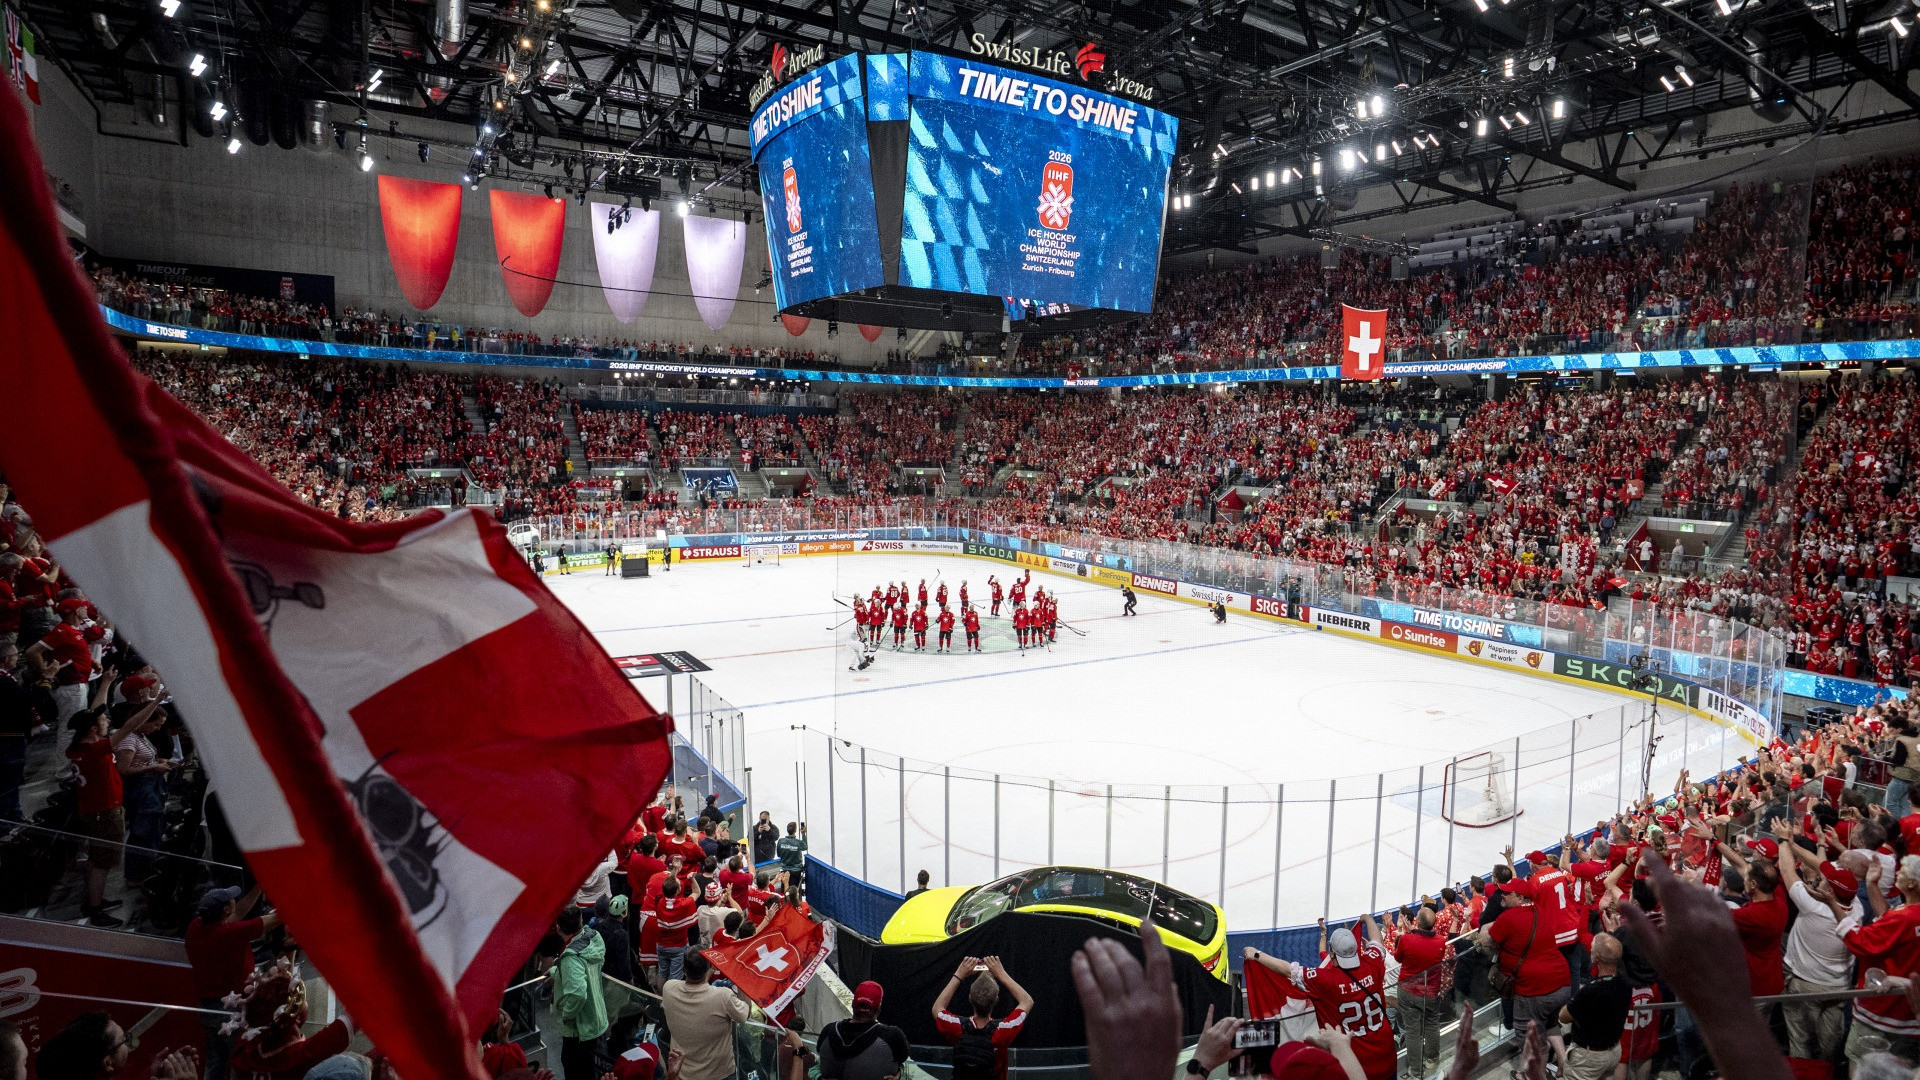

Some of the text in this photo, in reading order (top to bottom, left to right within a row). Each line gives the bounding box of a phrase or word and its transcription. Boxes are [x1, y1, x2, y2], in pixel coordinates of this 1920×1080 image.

[788, 44, 824, 76] Arena
[970, 33, 1071, 76] SwissLife
[958, 67, 1138, 135] TIME TO SHINE
[753, 76, 823, 147] TIME TO SHINE
[1048, 150, 1072, 163] 2026
[1047, 169, 1069, 182] IIHF
[1028, 228, 1077, 243] ICE HOCKEY
[1037, 238, 1067, 249] WORLD
[1019, 243, 1081, 260] CHAMPIONSHIP
[1025, 254, 1075, 268] SWITZERLAND
[136, 264, 188, 276] TIMEOUT
[1022, 262, 1044, 273] Zurich
[1048, 266, 1075, 278] Fribourg
[655, 364, 683, 372] HOCKEY
[707, 367, 757, 376] CHAMPIONSHIP
[1394, 365, 1422, 373] HOCKEY
[1422, 363, 1448, 373] WORLD
[1448, 361, 1507, 372] CHAMPIONSHIP
[693, 546, 739, 557] STRAUSS
[802, 544, 825, 552] allegro
[829, 543, 851, 552] allegro
[875, 541, 904, 550] SWISS
[1059, 560, 1076, 570] TISSOT
[1100, 569, 1130, 583] PostFinance
[1014, 586, 1023, 594] 20
[1133, 574, 1176, 594] DENNER
[1191, 587, 1225, 604] SwissLife
[1256, 598, 1304, 621] SRG SR
[1317, 612, 1371, 632] LIEBHERR
[1414, 609, 1505, 638] TIME TO SHINE
[1404, 629, 1446, 648] Sunrise
[1488, 643, 1518, 655] Happiness
[1554, 881, 1567, 910] 1
[795, 948, 828, 991] DENNER
[1338, 983, 1348, 995] T.
[1338, 992, 1385, 1037] 28
